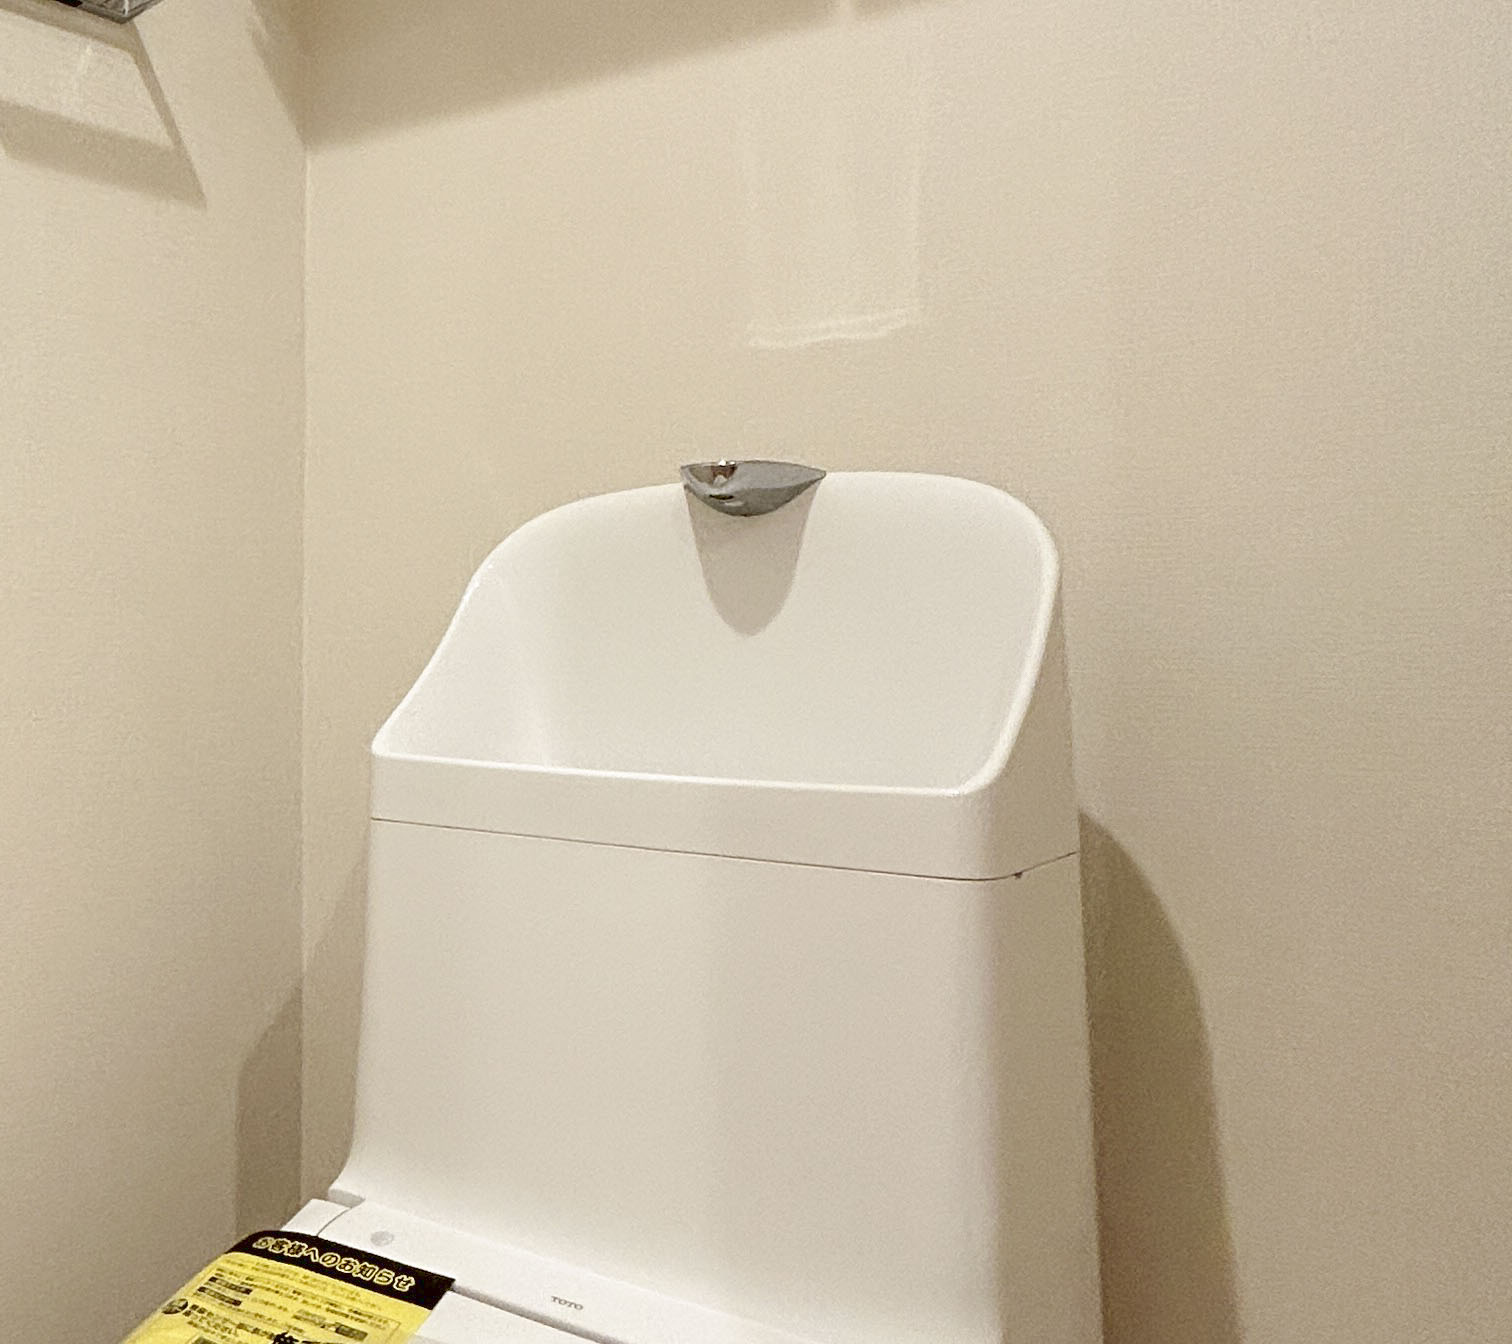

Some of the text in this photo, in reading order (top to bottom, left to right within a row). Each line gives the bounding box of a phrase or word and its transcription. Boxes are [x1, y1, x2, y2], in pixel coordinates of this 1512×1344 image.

[252, 1236, 416, 1293] お客様へのお知らせ
[550, 1295, 584, 1311] TOTO
